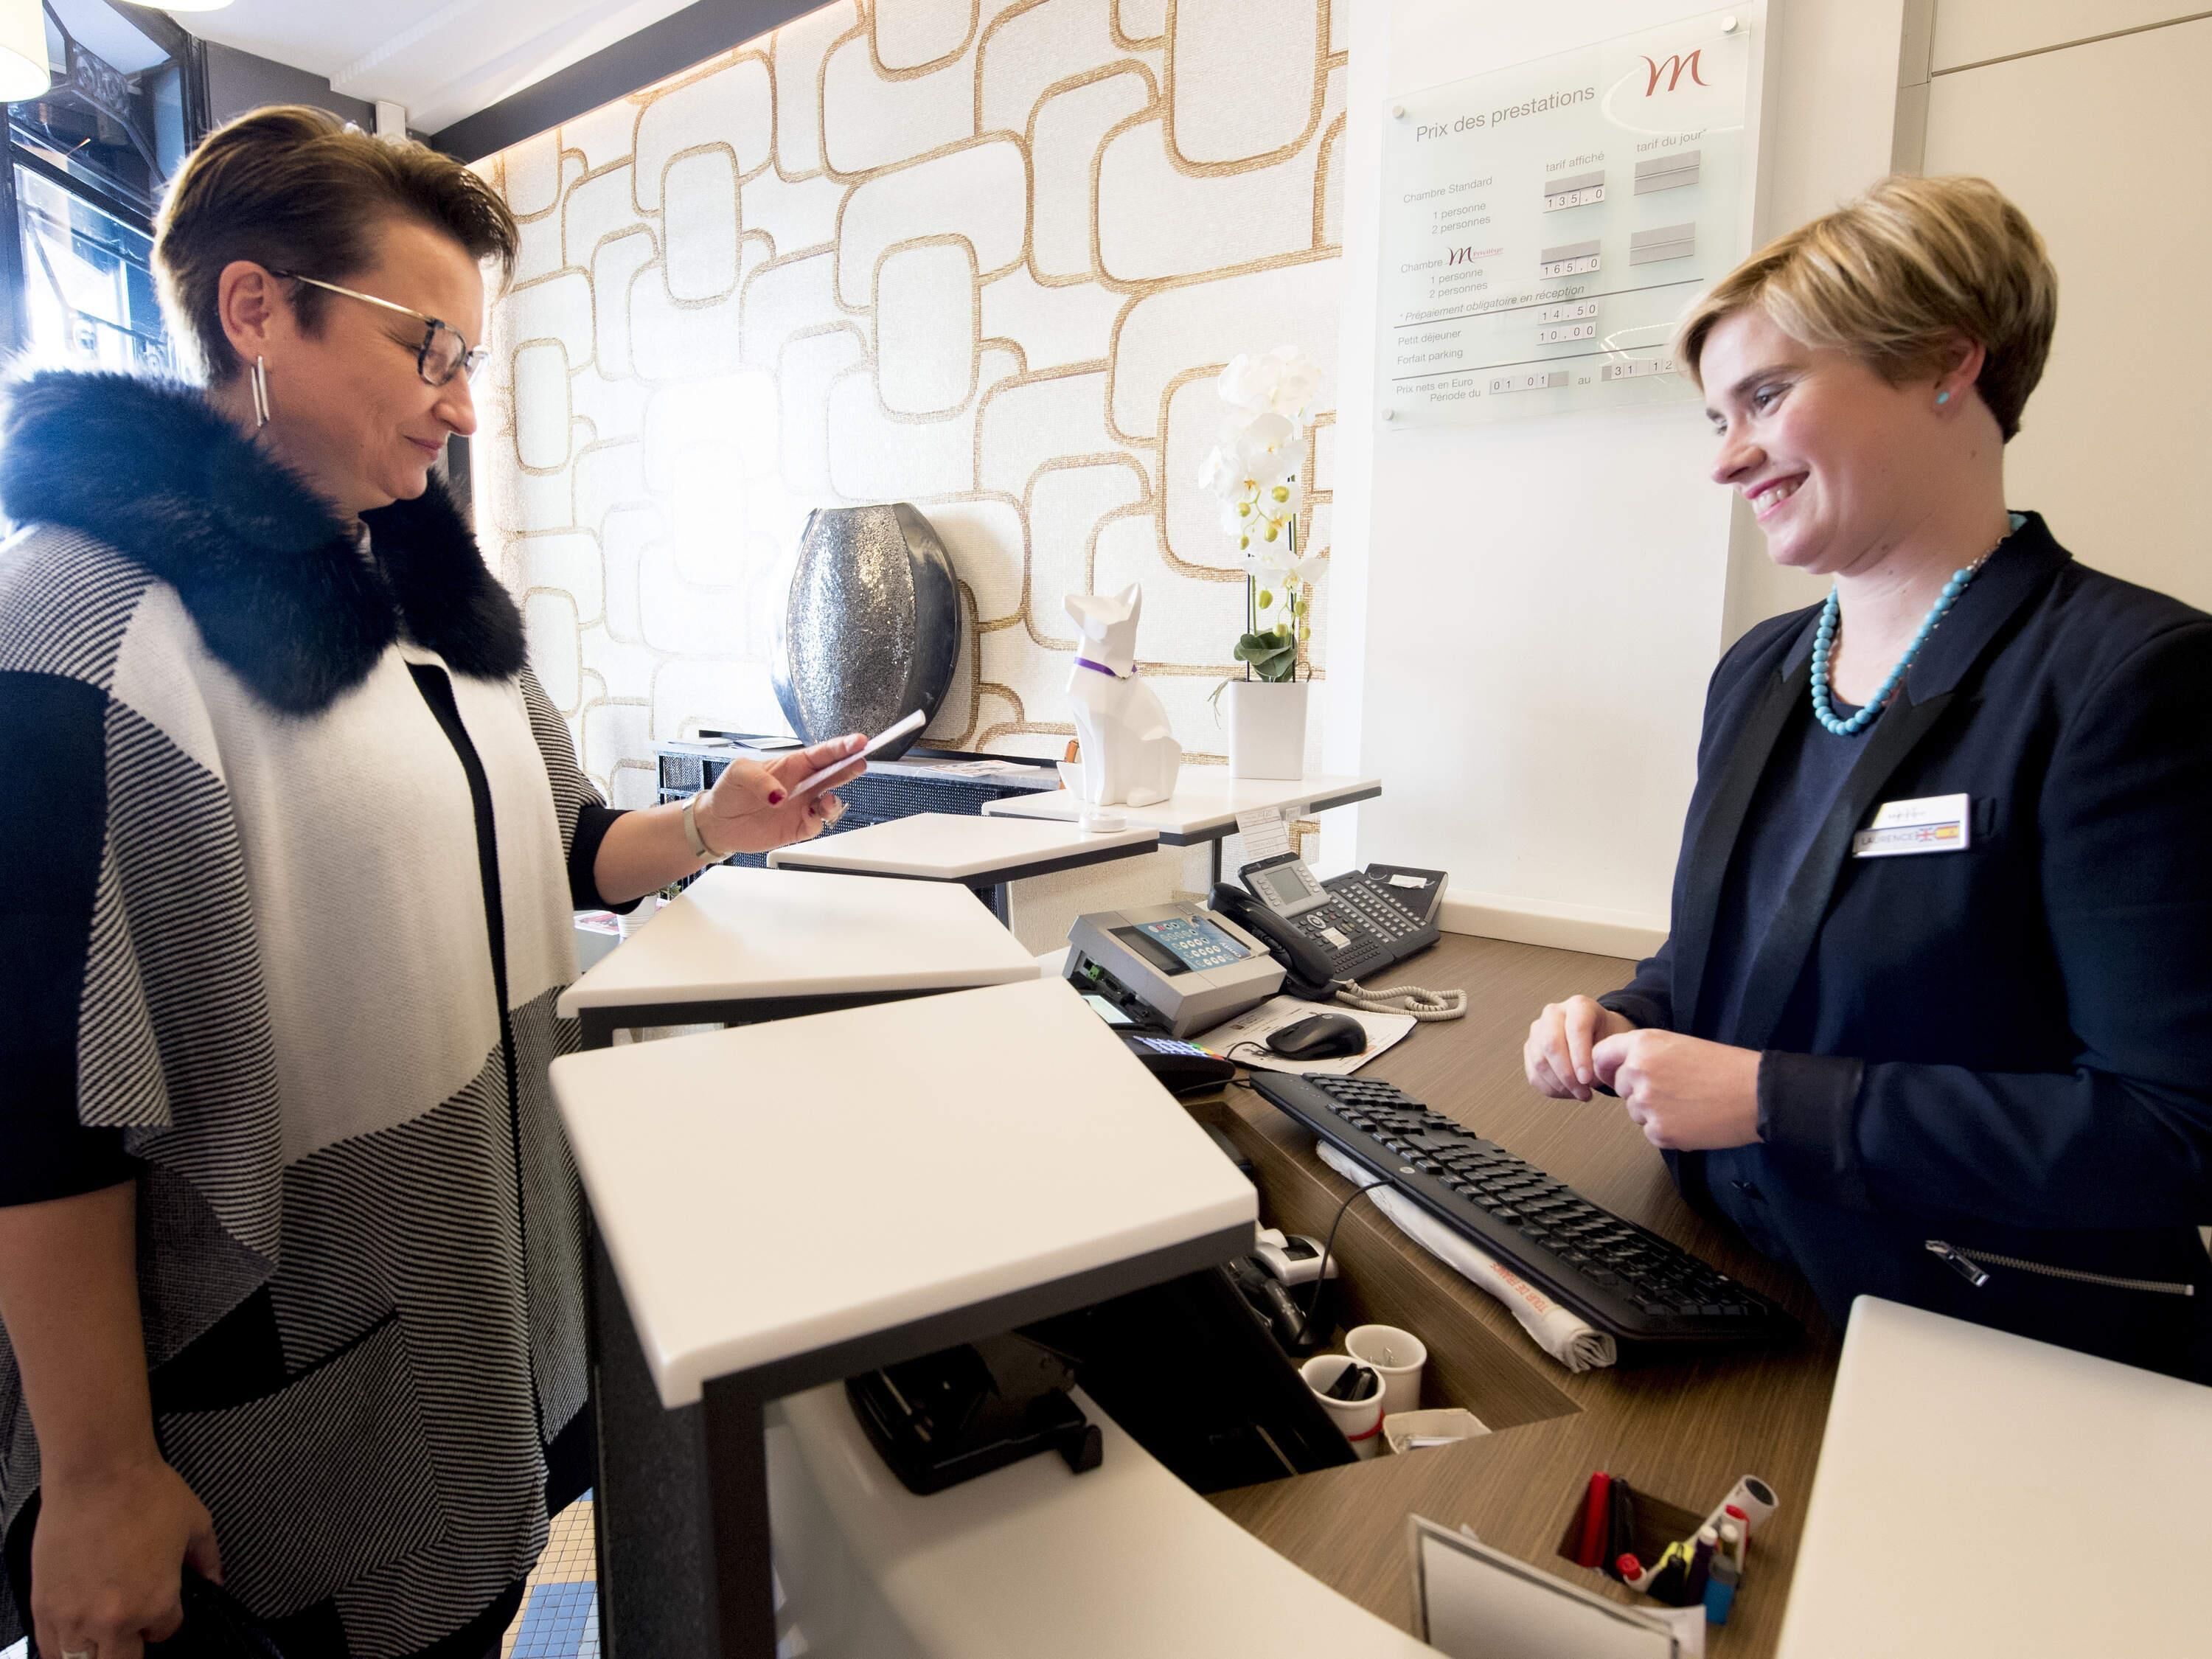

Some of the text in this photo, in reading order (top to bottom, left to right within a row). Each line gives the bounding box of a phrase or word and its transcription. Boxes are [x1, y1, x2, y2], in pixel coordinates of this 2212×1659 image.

[1416, 86, 1596, 142] Prix des prestations
[1636, 137, 1659, 153] tarif
[1661, 136, 1677, 147] du
[1545, 150, 1605, 173] tarif affiché
[1403, 175, 1493, 204] Chambre Standard
[1433, 202, 1486, 220] 1 personne
[1432, 215, 1492, 235] 2 personnes
[1400, 258, 1444, 274] Chambre
[1430, 268, 1484, 285] 1 personne
[1429, 282, 1489, 300] 2 personnes
[1405, 285, 1585, 321] Prépaiement obligatoire en réception
[1398, 330, 1462, 347] Petit déjeuner
[1397, 349, 1464, 365] Forfait parking
[1397, 385, 1414, 395] Prix
[1416, 383, 1435, 392] nets
[1451, 378, 1474, 388] Euro
[1468, 388, 1481, 399] du
[1578, 375, 1591, 386] au
